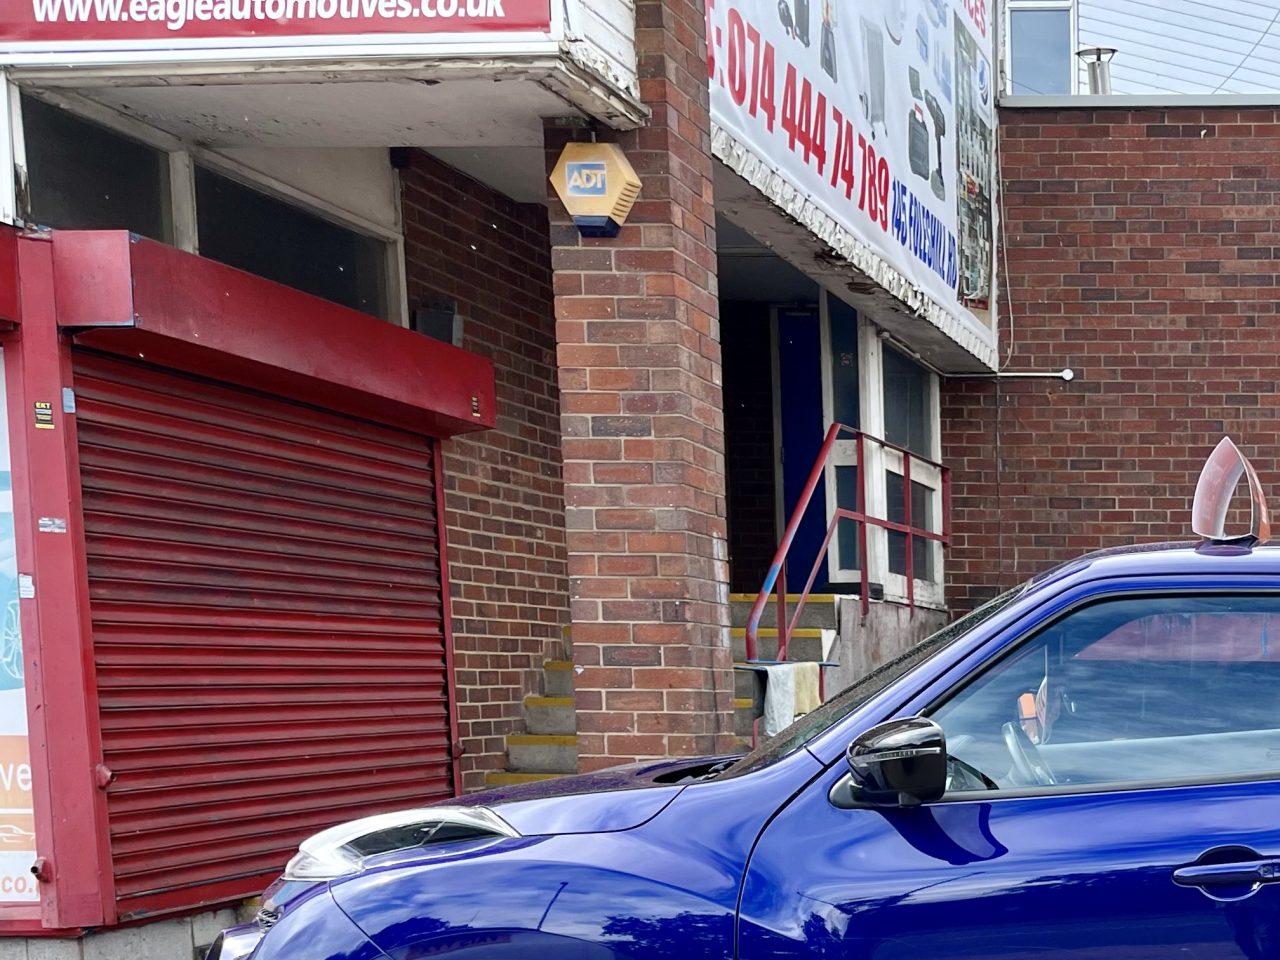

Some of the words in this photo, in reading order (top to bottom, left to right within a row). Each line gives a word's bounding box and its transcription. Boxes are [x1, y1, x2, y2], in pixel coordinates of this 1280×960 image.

[568, 169, 606, 189] ADT
[728, 8, 776, 134] 074
[782, 62, 827, 176] 444
[831, 106, 854, 200] 74
[858, 133, 889, 232] 789
[892, 177, 908, 246] 145
[909, 192, 946, 280] FOLESHILL
